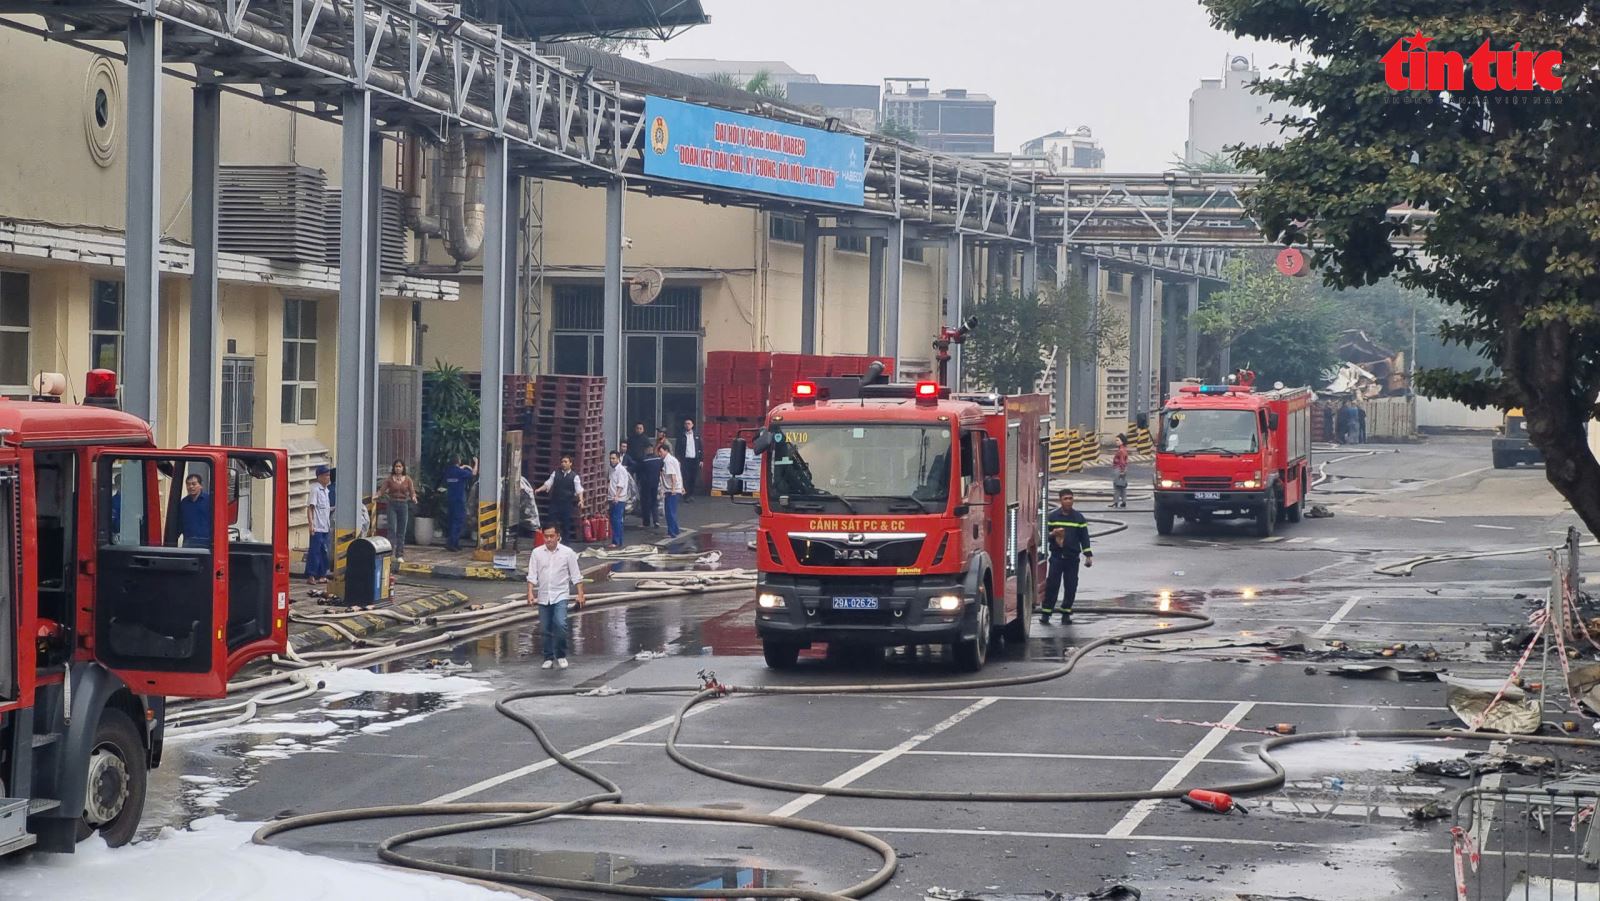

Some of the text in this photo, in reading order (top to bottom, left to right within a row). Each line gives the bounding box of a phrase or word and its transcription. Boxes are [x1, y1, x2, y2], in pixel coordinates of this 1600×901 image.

[741, 127, 746, 146] V
[747, 127, 764, 149] CÔNG
[783, 135, 806, 157] HABECO
[785, 432, 808, 443] KV10
[809, 517, 905, 530] CẢNH SÁT PC & CC
[834, 550, 878, 559] MAN
